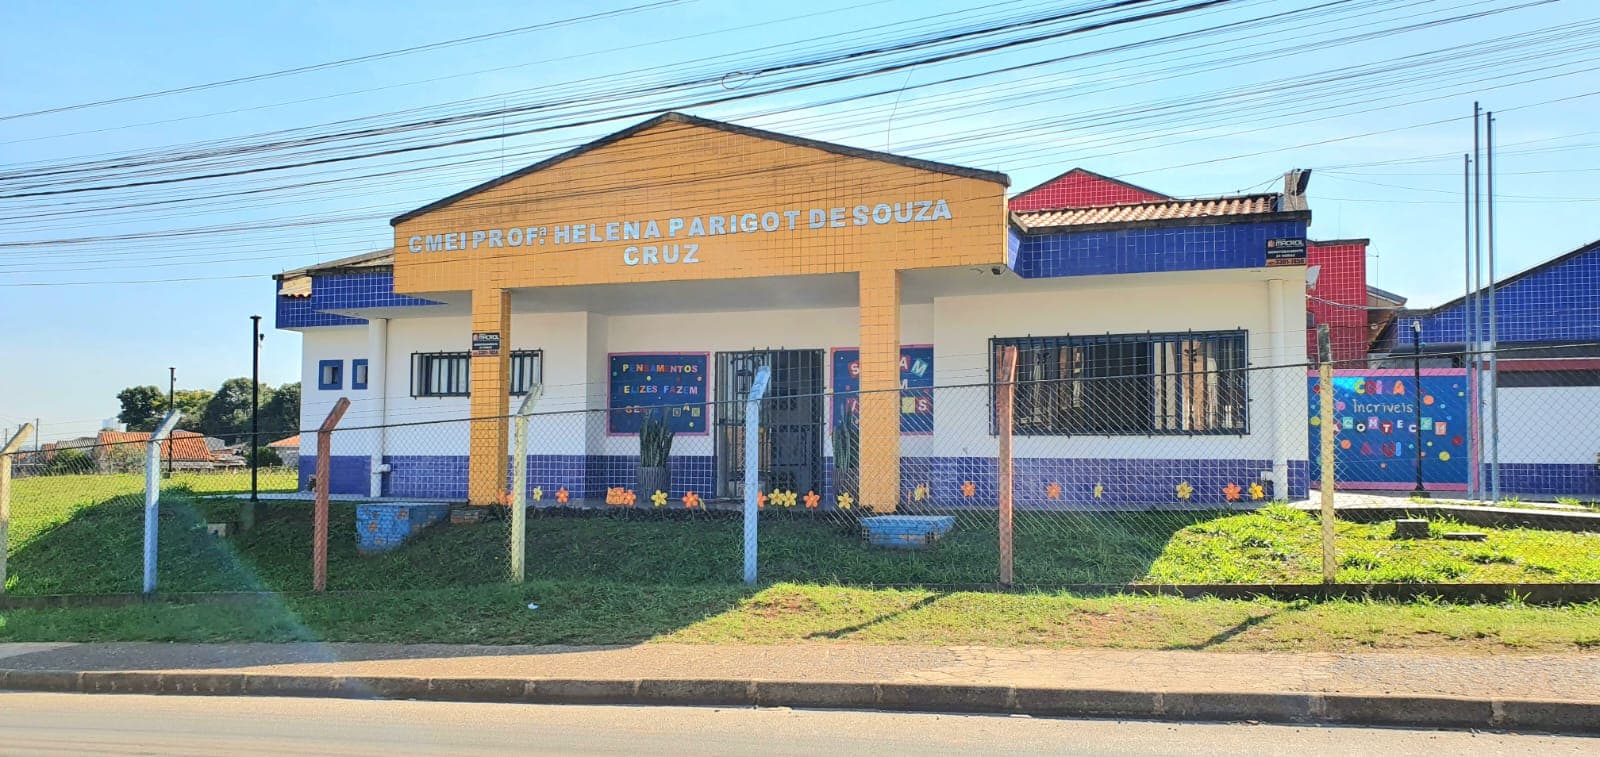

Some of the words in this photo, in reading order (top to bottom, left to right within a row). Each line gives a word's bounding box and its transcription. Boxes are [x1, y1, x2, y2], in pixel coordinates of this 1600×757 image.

[408, 230, 467, 253] CMEI
[554, 219, 661, 244] HELENA
[669, 210, 801, 237] PARIGOT
[808, 207, 848, 229] DE
[852, 199, 953, 226] SOUZA
[623, 244, 700, 266] CRUZ
[622, 364, 698, 374] PENSAMENTOS
[850, 356, 928, 378] SAM
[663, 385, 698, 395] FAZEM
[1333, 416, 1447, 436] ACONTECEM
